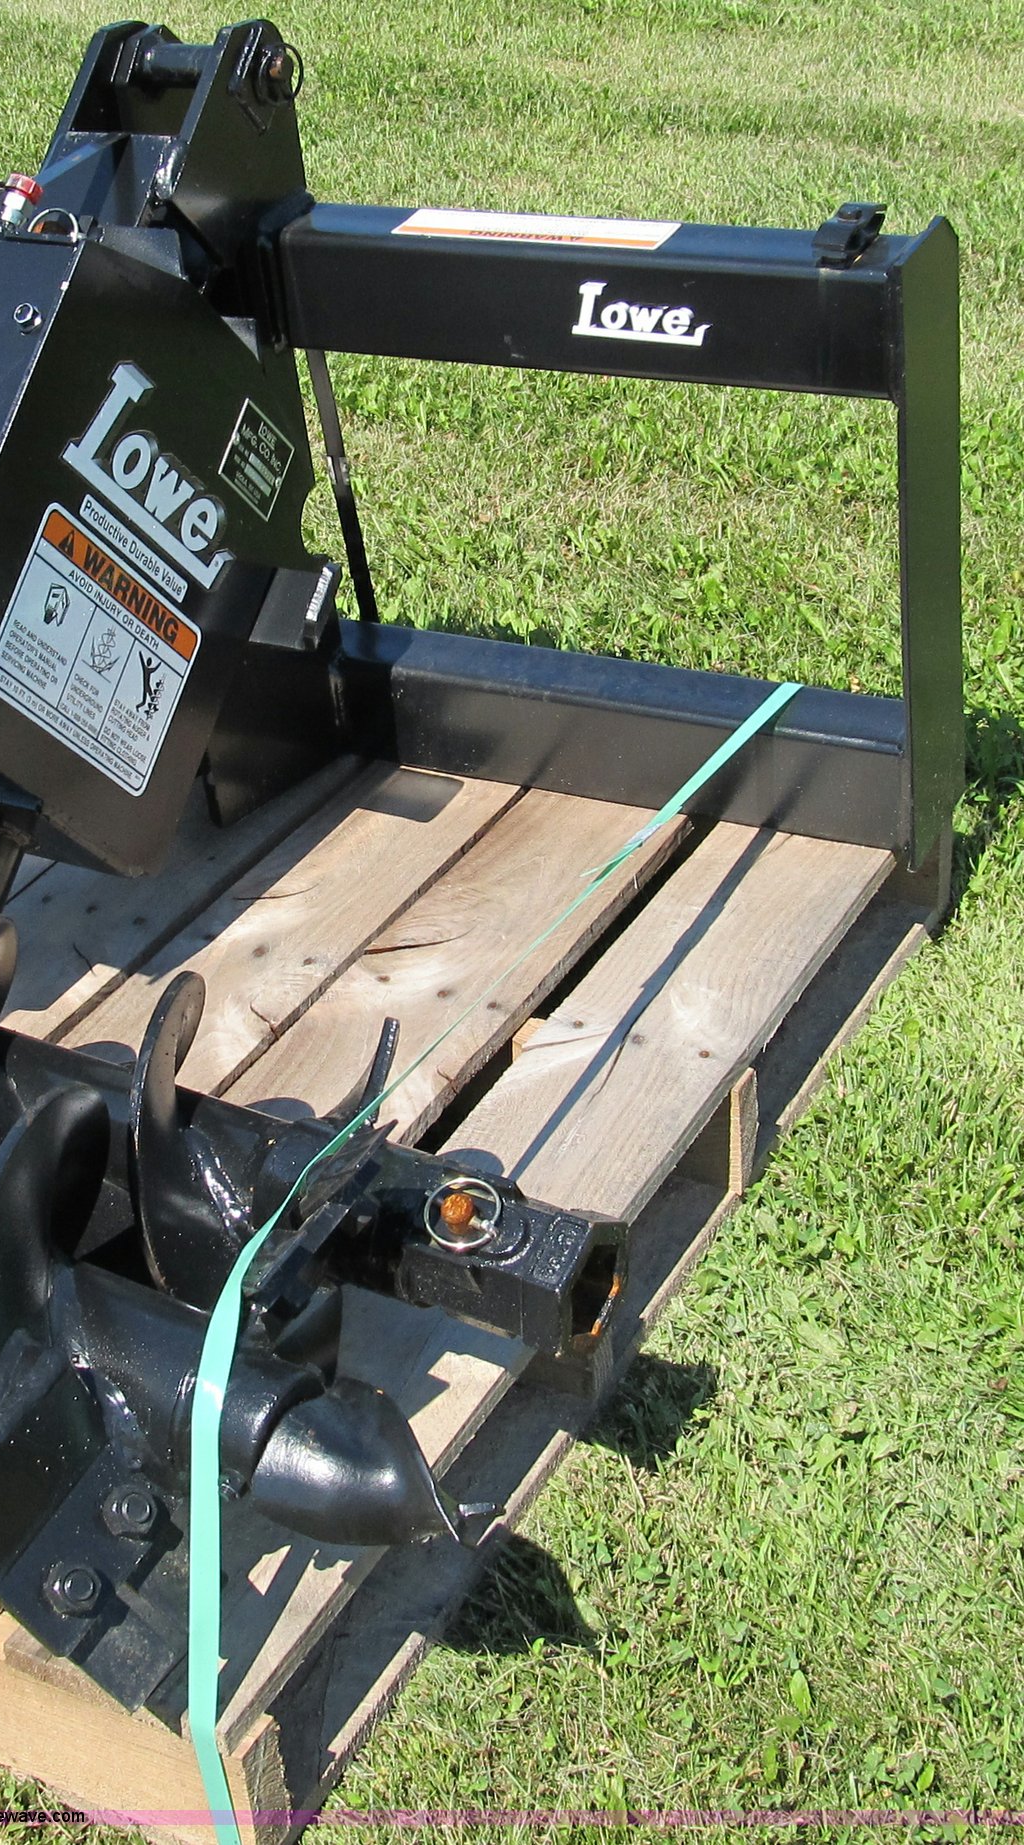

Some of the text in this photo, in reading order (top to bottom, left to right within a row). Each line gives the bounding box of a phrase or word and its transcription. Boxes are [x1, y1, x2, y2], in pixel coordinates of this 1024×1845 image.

[469, 230, 564, 242] WARNING
[572, 282, 713, 346] Lowe
[258, 421, 278, 450] LOWE
[61, 362, 234, 590] Lowe
[82, 500, 130, 548] Productive
[128, 541, 161, 576] Durable
[68, 569, 159, 650] AVOID INJURY OR DEATH
[82, 544, 180, 644] WARNING
